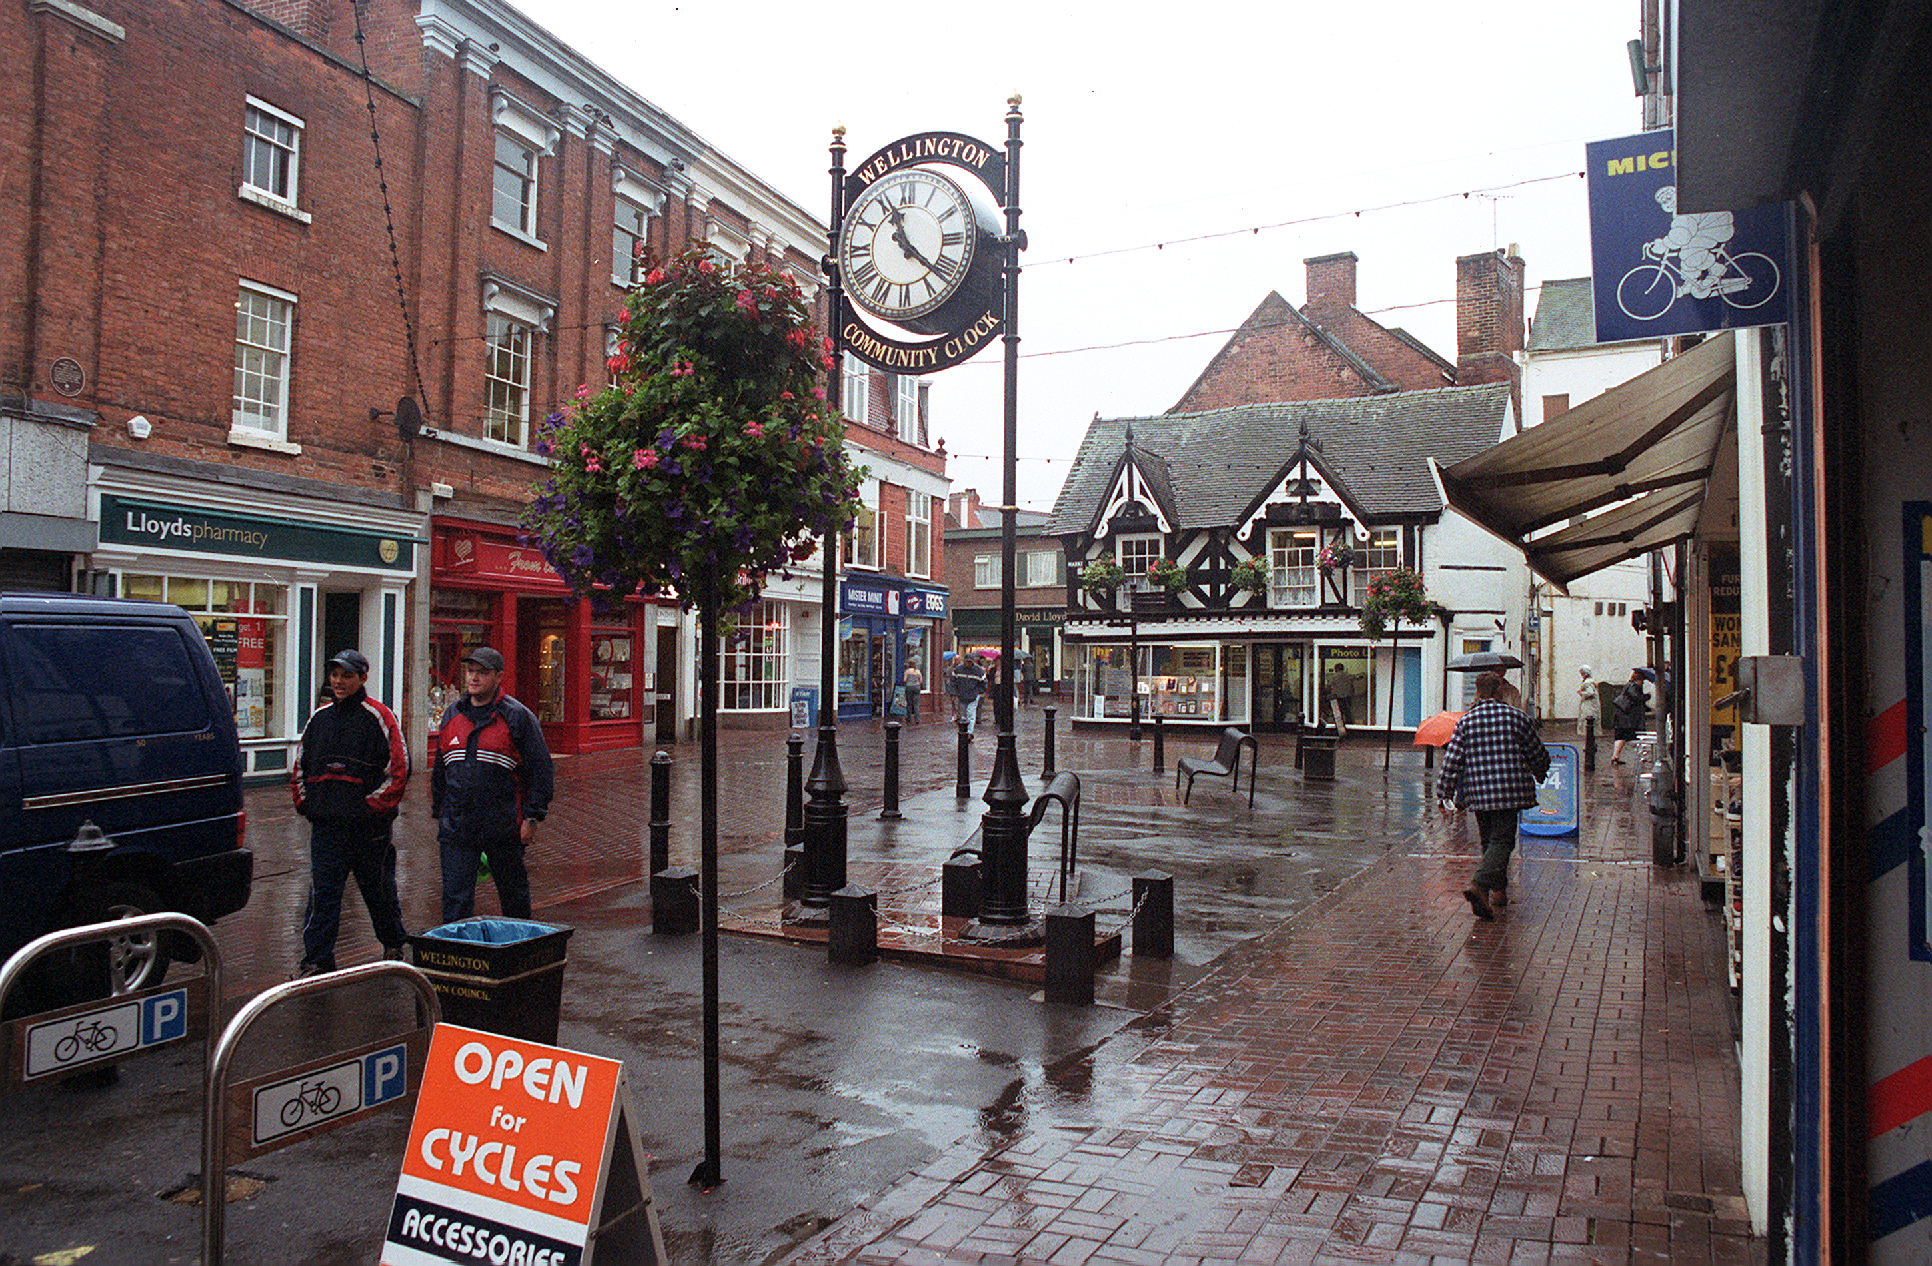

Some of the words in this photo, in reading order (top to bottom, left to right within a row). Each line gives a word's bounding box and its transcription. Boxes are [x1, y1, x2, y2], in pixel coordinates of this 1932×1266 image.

[858, 138, 990, 185] WELLINGTON
[843, 322, 940, 368] COMMUNITY
[945, 309, 1000, 358] CLOCK
[126, 511, 268, 550] Lloydspharmacy
[508, 551, 542, 573] From
[1015, 612, 1041, 622] David
[1043, 611, 1068, 623] Lloyd
[1330, 648, 1360, 658] Photo
[420, 951, 490, 971] WELLINGTON
[451, 986, 491, 1001] COUNCIL
[153, 997, 179, 1040] P
[374, 1054, 399, 1101] P
[454, 1042, 588, 1110] OPEN
[490, 1105, 527, 1133] for
[421, 1128, 582, 1205] CYCLES
